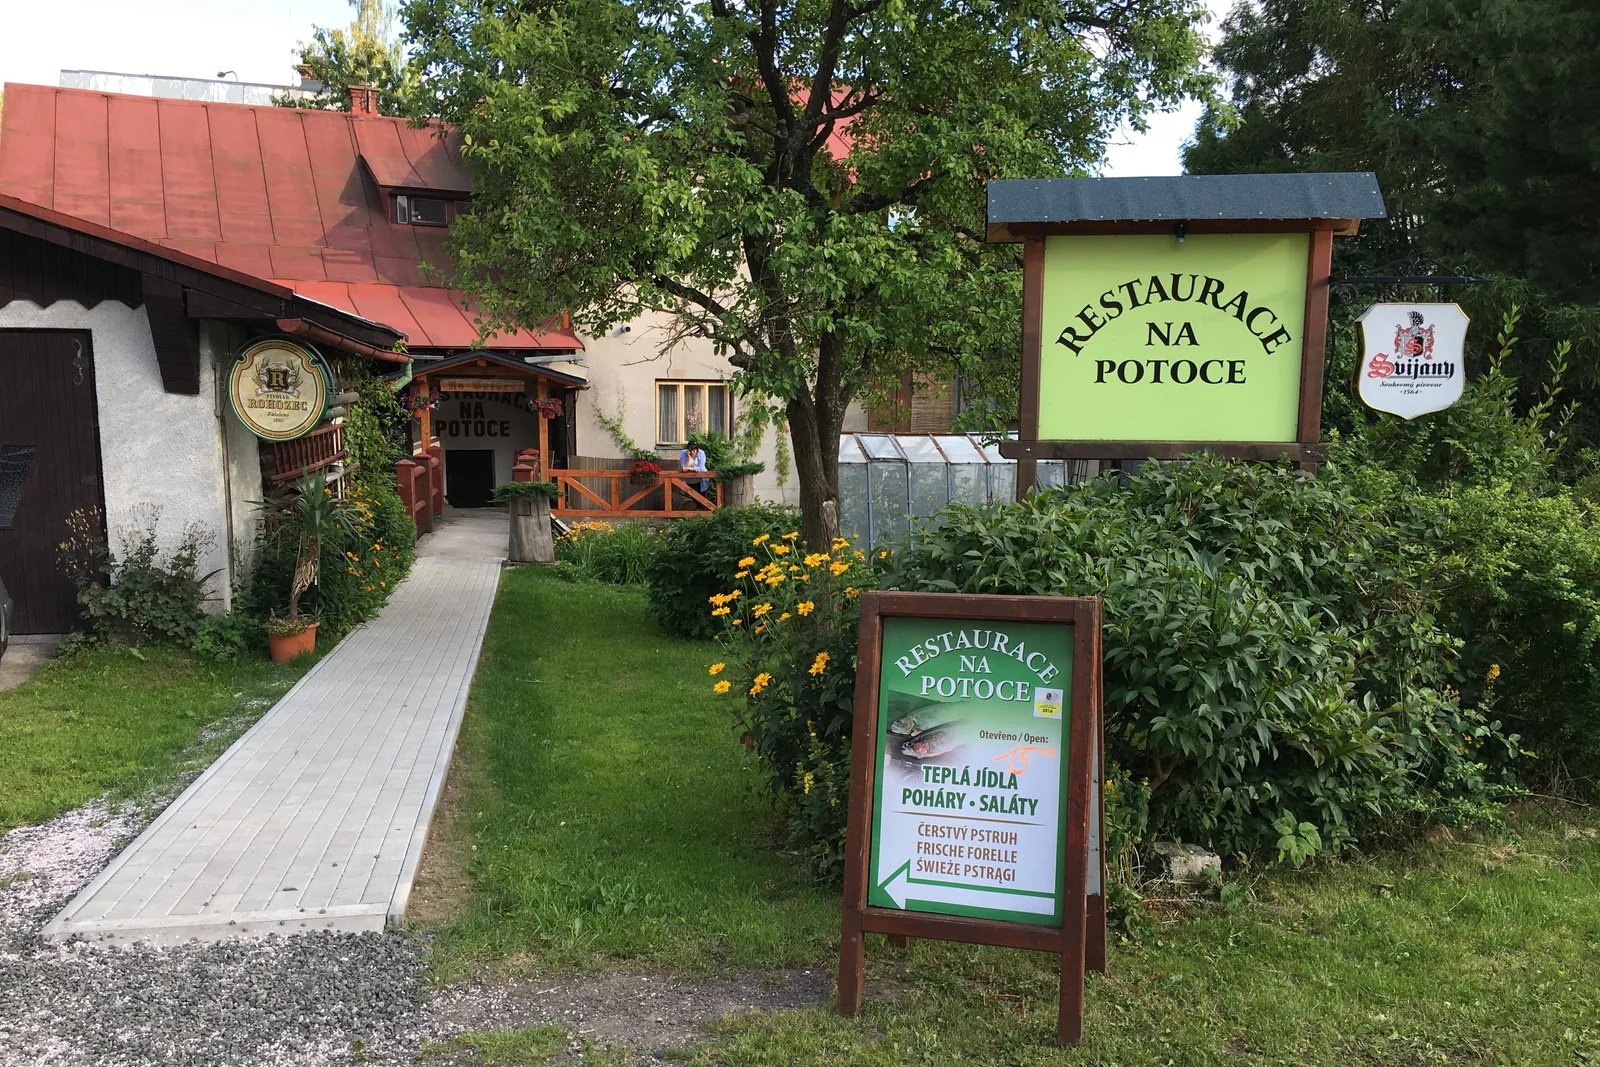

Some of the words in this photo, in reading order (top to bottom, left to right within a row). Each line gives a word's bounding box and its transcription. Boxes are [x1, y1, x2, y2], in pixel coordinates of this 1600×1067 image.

[1055, 273, 1292, 357] RESTAURACE
[1145, 322, 1200, 346] NA
[1094, 360, 1247, 384] POTOCE
[1367, 352, 1455, 380] Svijany
[247, 399, 308, 411] ROHOZEC
[460, 402, 485, 419] NA
[436, 421, 510, 438] POTOCE
[894, 629, 1059, 684] RESTAURACE
[959, 655, 992, 674] NA
[920, 676, 1031, 702] POTOCE
[980, 730, 1017, 741] Otevřeno
[1024, 733, 1048, 744] Open:
[922, 765, 970, 786] TEPLÁ
[973, 767, 1018, 790] JÍDLA
[902, 788, 966, 809] POHÁRY
[979, 794, 1039, 816] SALÁTY
[918, 821, 968, 840] ČERSTVÝ
[970, 828, 1017, 845] PSTRUH
[916, 842, 964, 858] FRISCHE
[967, 846, 1017, 863] FORELLE
[916, 857, 960, 876] ŚWIEŻE
[964, 864, 1015, 884] PSTRĄGI
